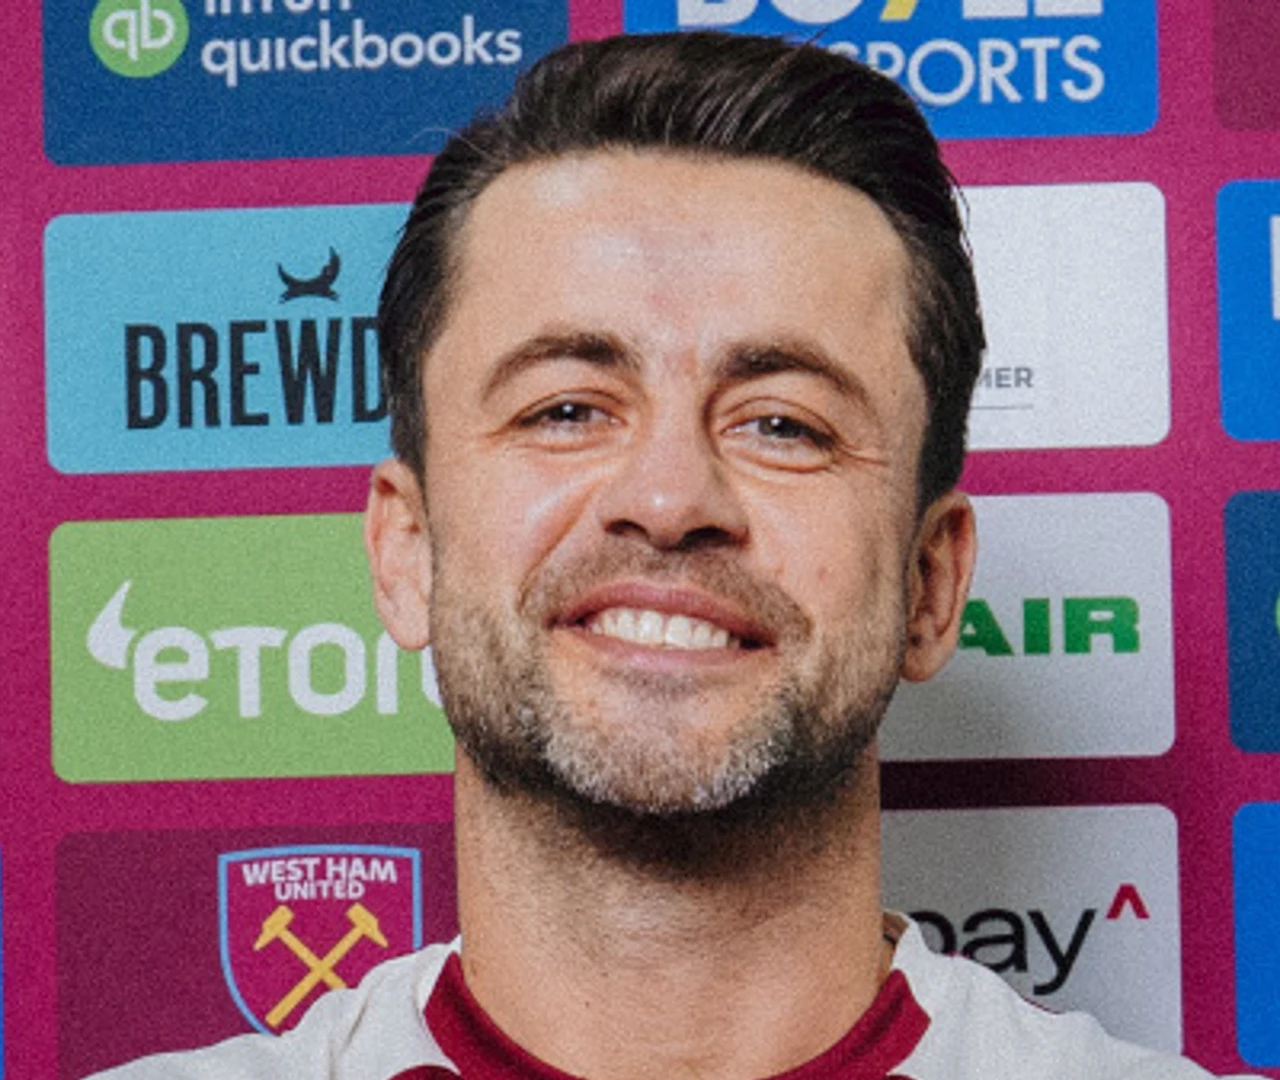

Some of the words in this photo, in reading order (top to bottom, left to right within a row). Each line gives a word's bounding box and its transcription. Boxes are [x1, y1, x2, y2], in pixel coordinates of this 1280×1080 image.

[201, 15, 523, 88] quickbooks
[125, 318, 390, 430] BREWD
[241, 857, 320, 882] WEST
[325, 856, 398, 881] HAM
[274, 878, 365, 900] UNITED
